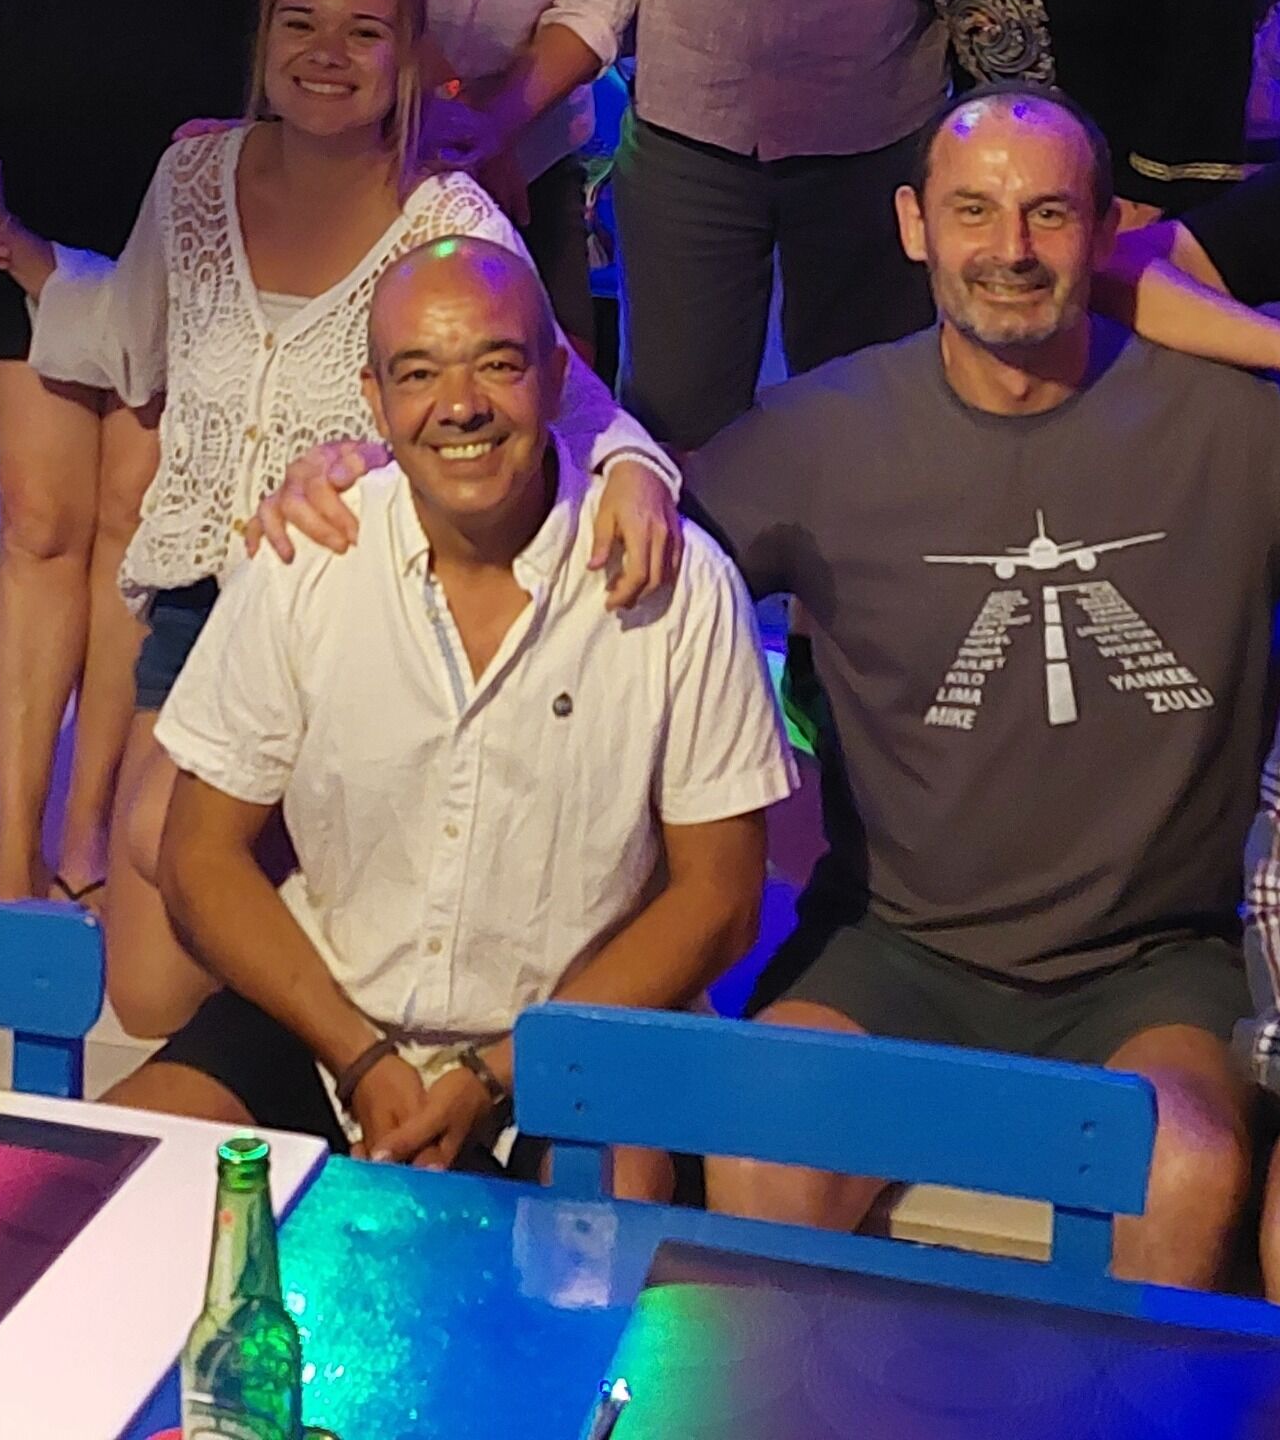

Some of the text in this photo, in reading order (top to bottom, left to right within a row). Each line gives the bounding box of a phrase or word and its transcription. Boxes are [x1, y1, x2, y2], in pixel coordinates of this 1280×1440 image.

[1108, 667, 1198, 690] YANKEE
[1144, 688, 1214, 713] ZULU
[924, 706, 977, 730] MIKE
